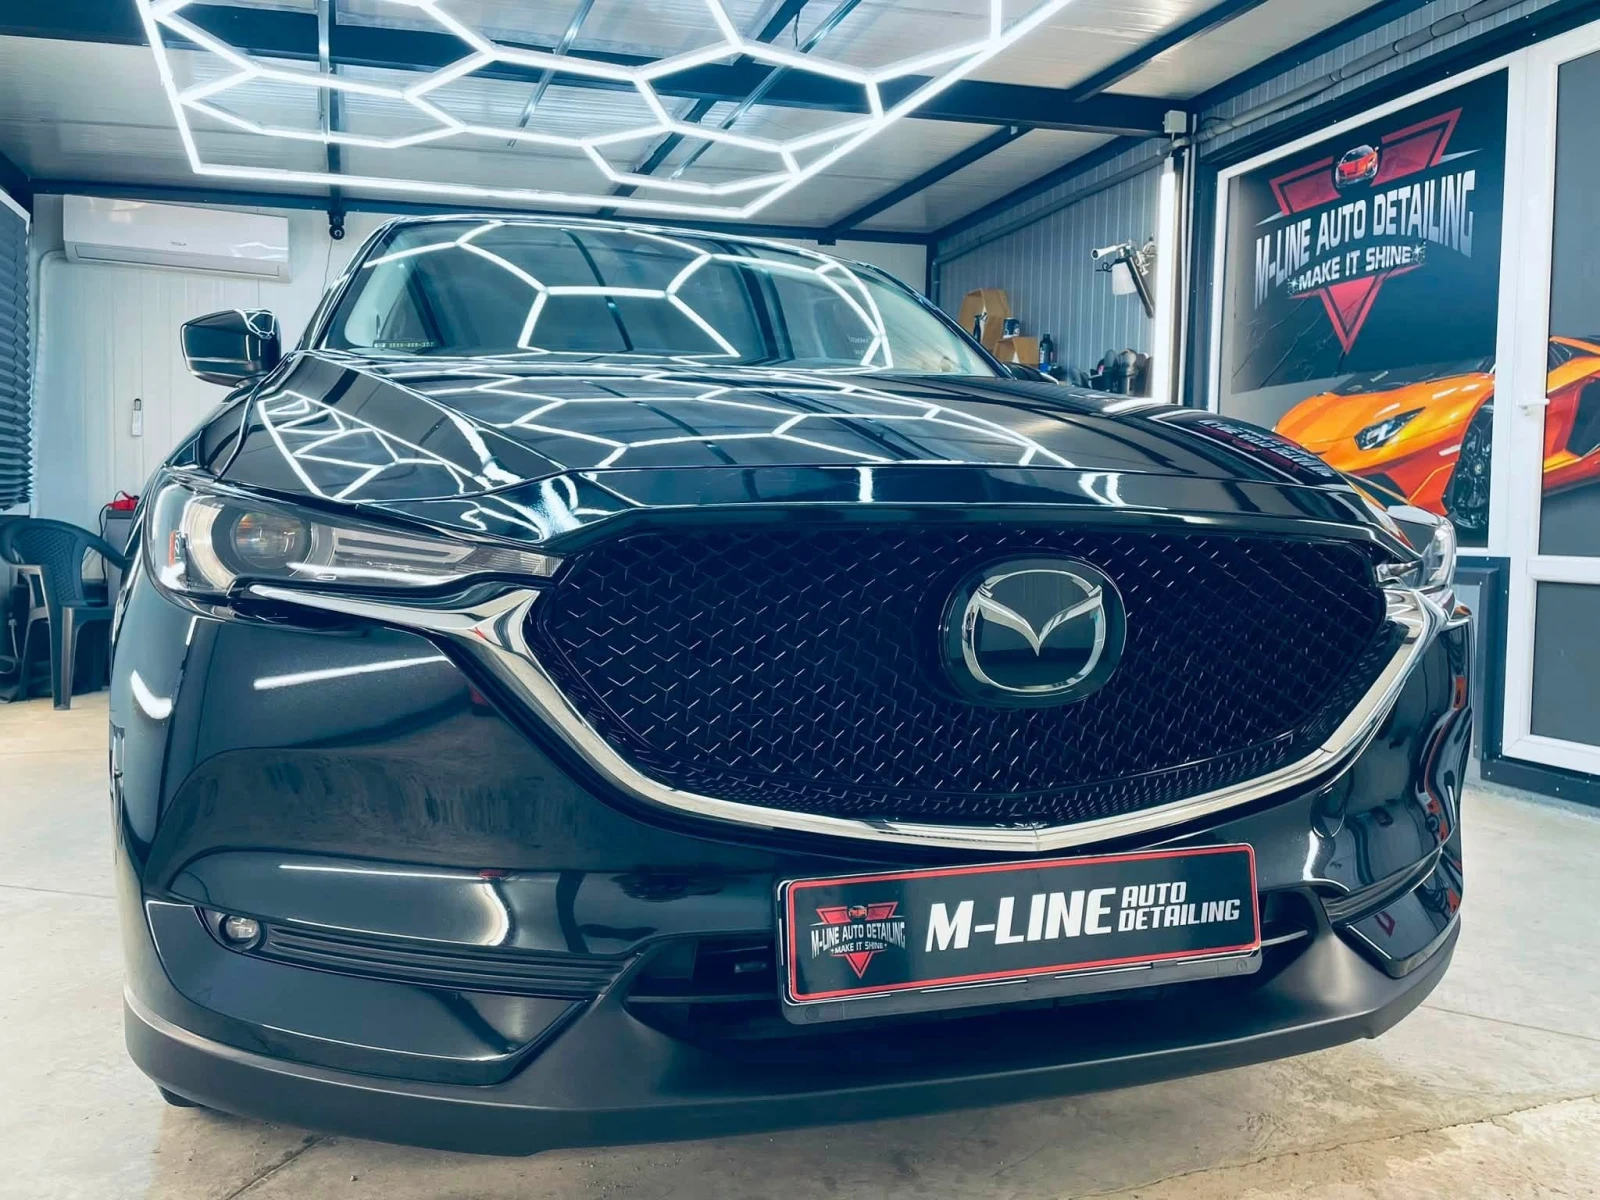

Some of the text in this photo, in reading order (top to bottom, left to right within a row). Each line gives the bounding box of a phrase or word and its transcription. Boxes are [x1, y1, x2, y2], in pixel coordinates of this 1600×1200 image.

[1254, 169, 1476, 311] M-LINE AUTO DETAILING
[1298, 245, 1413, 291] MAKE IT SHINE
[1121, 881, 1187, 908] AUTO
[925, 886, 1117, 952] M-LINE
[1117, 899, 1241, 932] DETAILING
[811, 921, 906, 959] M-LINE AUTO DETAILING
[834, 941, 884, 954] MAKE IT SHINE
